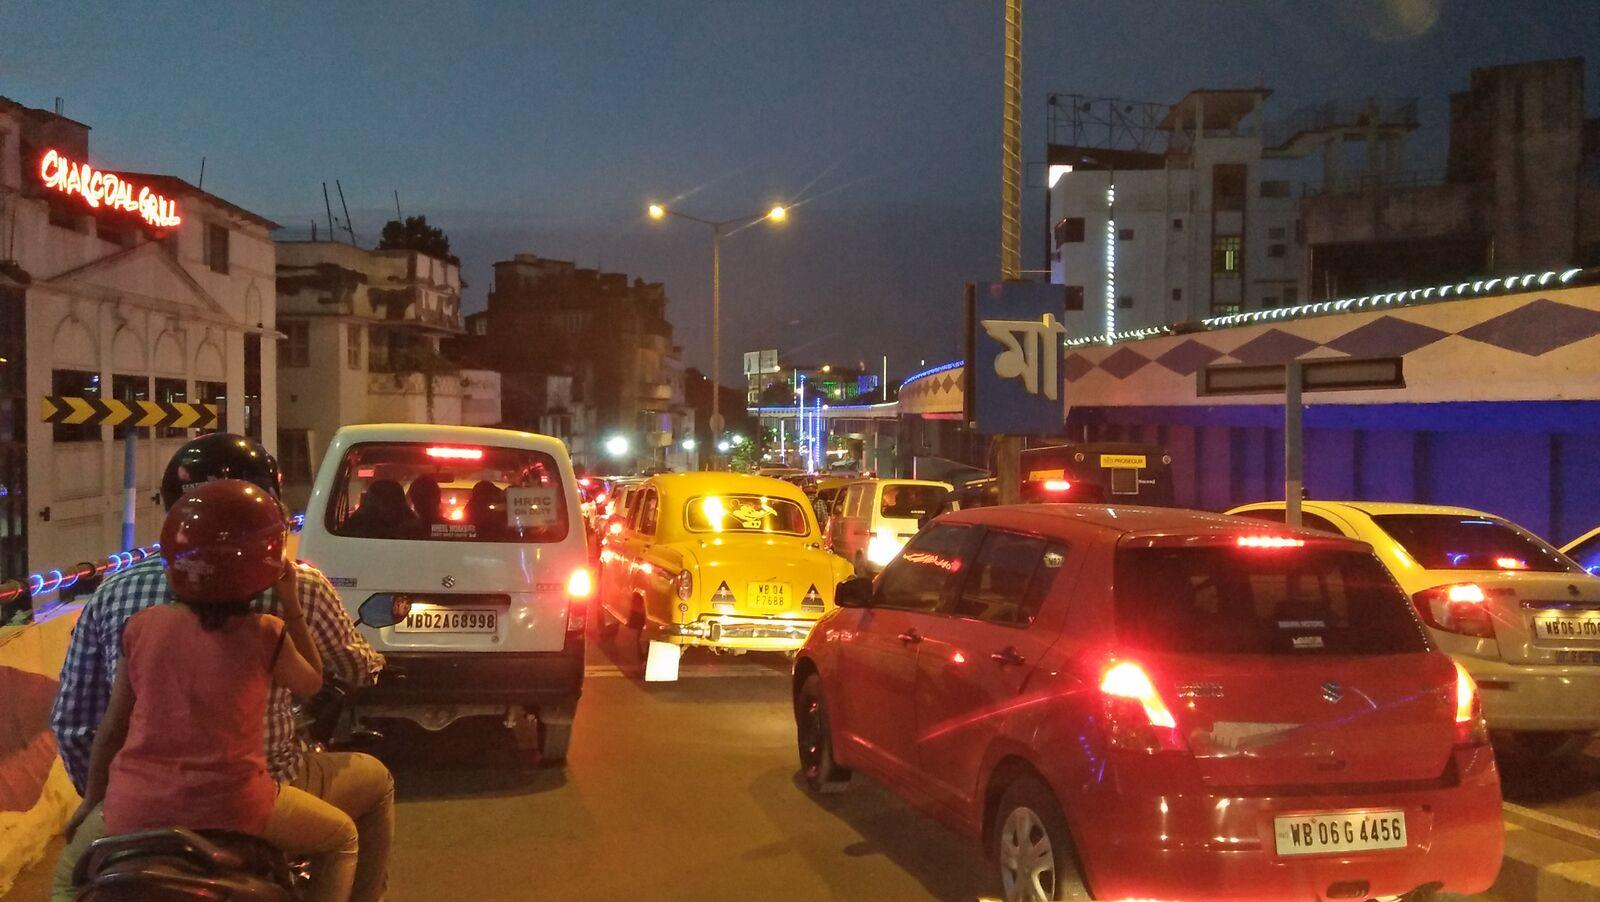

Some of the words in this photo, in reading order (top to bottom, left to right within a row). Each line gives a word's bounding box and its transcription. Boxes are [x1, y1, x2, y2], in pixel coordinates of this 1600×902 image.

[41, 149, 139, 212] CHARCOAL
[138, 185, 181, 227] GRILL
[980, 312, 1067, 400] মা
[758, 584, 769, 595] WB
[773, 584, 783, 595] 04
[406, 613, 495, 629] WB02AG8998
[1290, 822, 1314, 847] WB
[1318, 821, 1339, 845] 06
[1344, 820, 1354, 844] G
[1360, 817, 1401, 843] 4456
